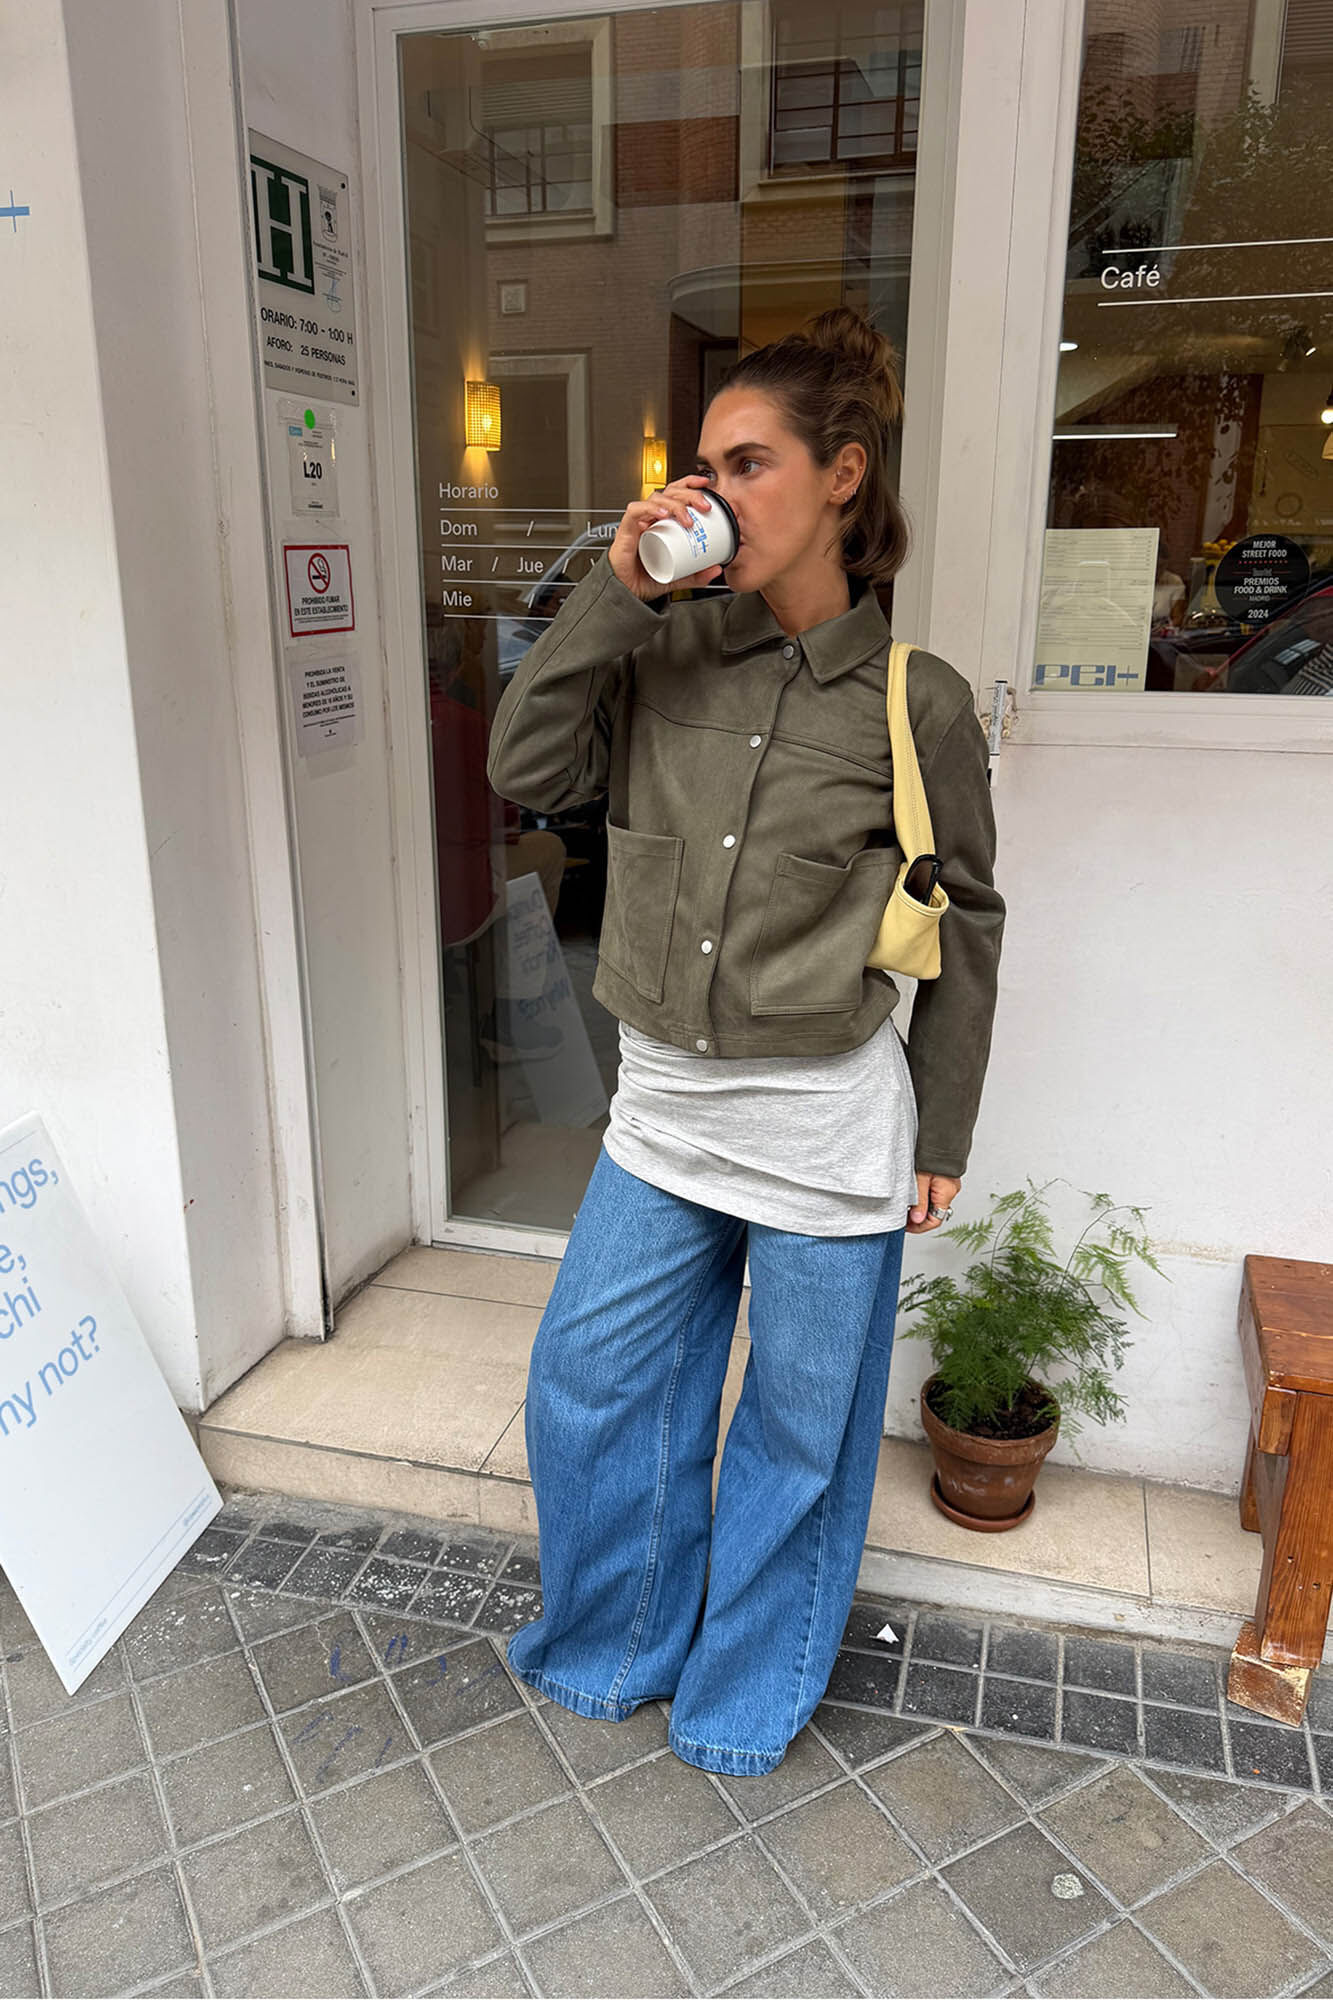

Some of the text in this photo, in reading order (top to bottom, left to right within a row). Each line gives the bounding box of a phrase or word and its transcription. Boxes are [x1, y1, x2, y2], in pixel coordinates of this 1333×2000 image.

[1100, 263, 1161, 290] Café
[299, 318, 319, 335] 7:00
[328, 327, 345, 343] 1:00
[347, 332, 353, 345] H
[266, 336, 346, 366] AFORO: 25 PERSONAS
[303, 461, 322, 480] L20
[439, 482, 499, 499] Horario
[440, 520, 478, 536] Dom
[1242, 550, 1267, 558] STREET
[441, 555, 473, 572] Mar
[516, 556, 545, 574] Jue
[1234, 586, 1254, 594] FOOD
[1255, 585, 1262, 594] &
[442, 591, 473, 607] Mie
[1248, 610, 1269, 618] 2024
[38, 1314, 100, 1396] not?
